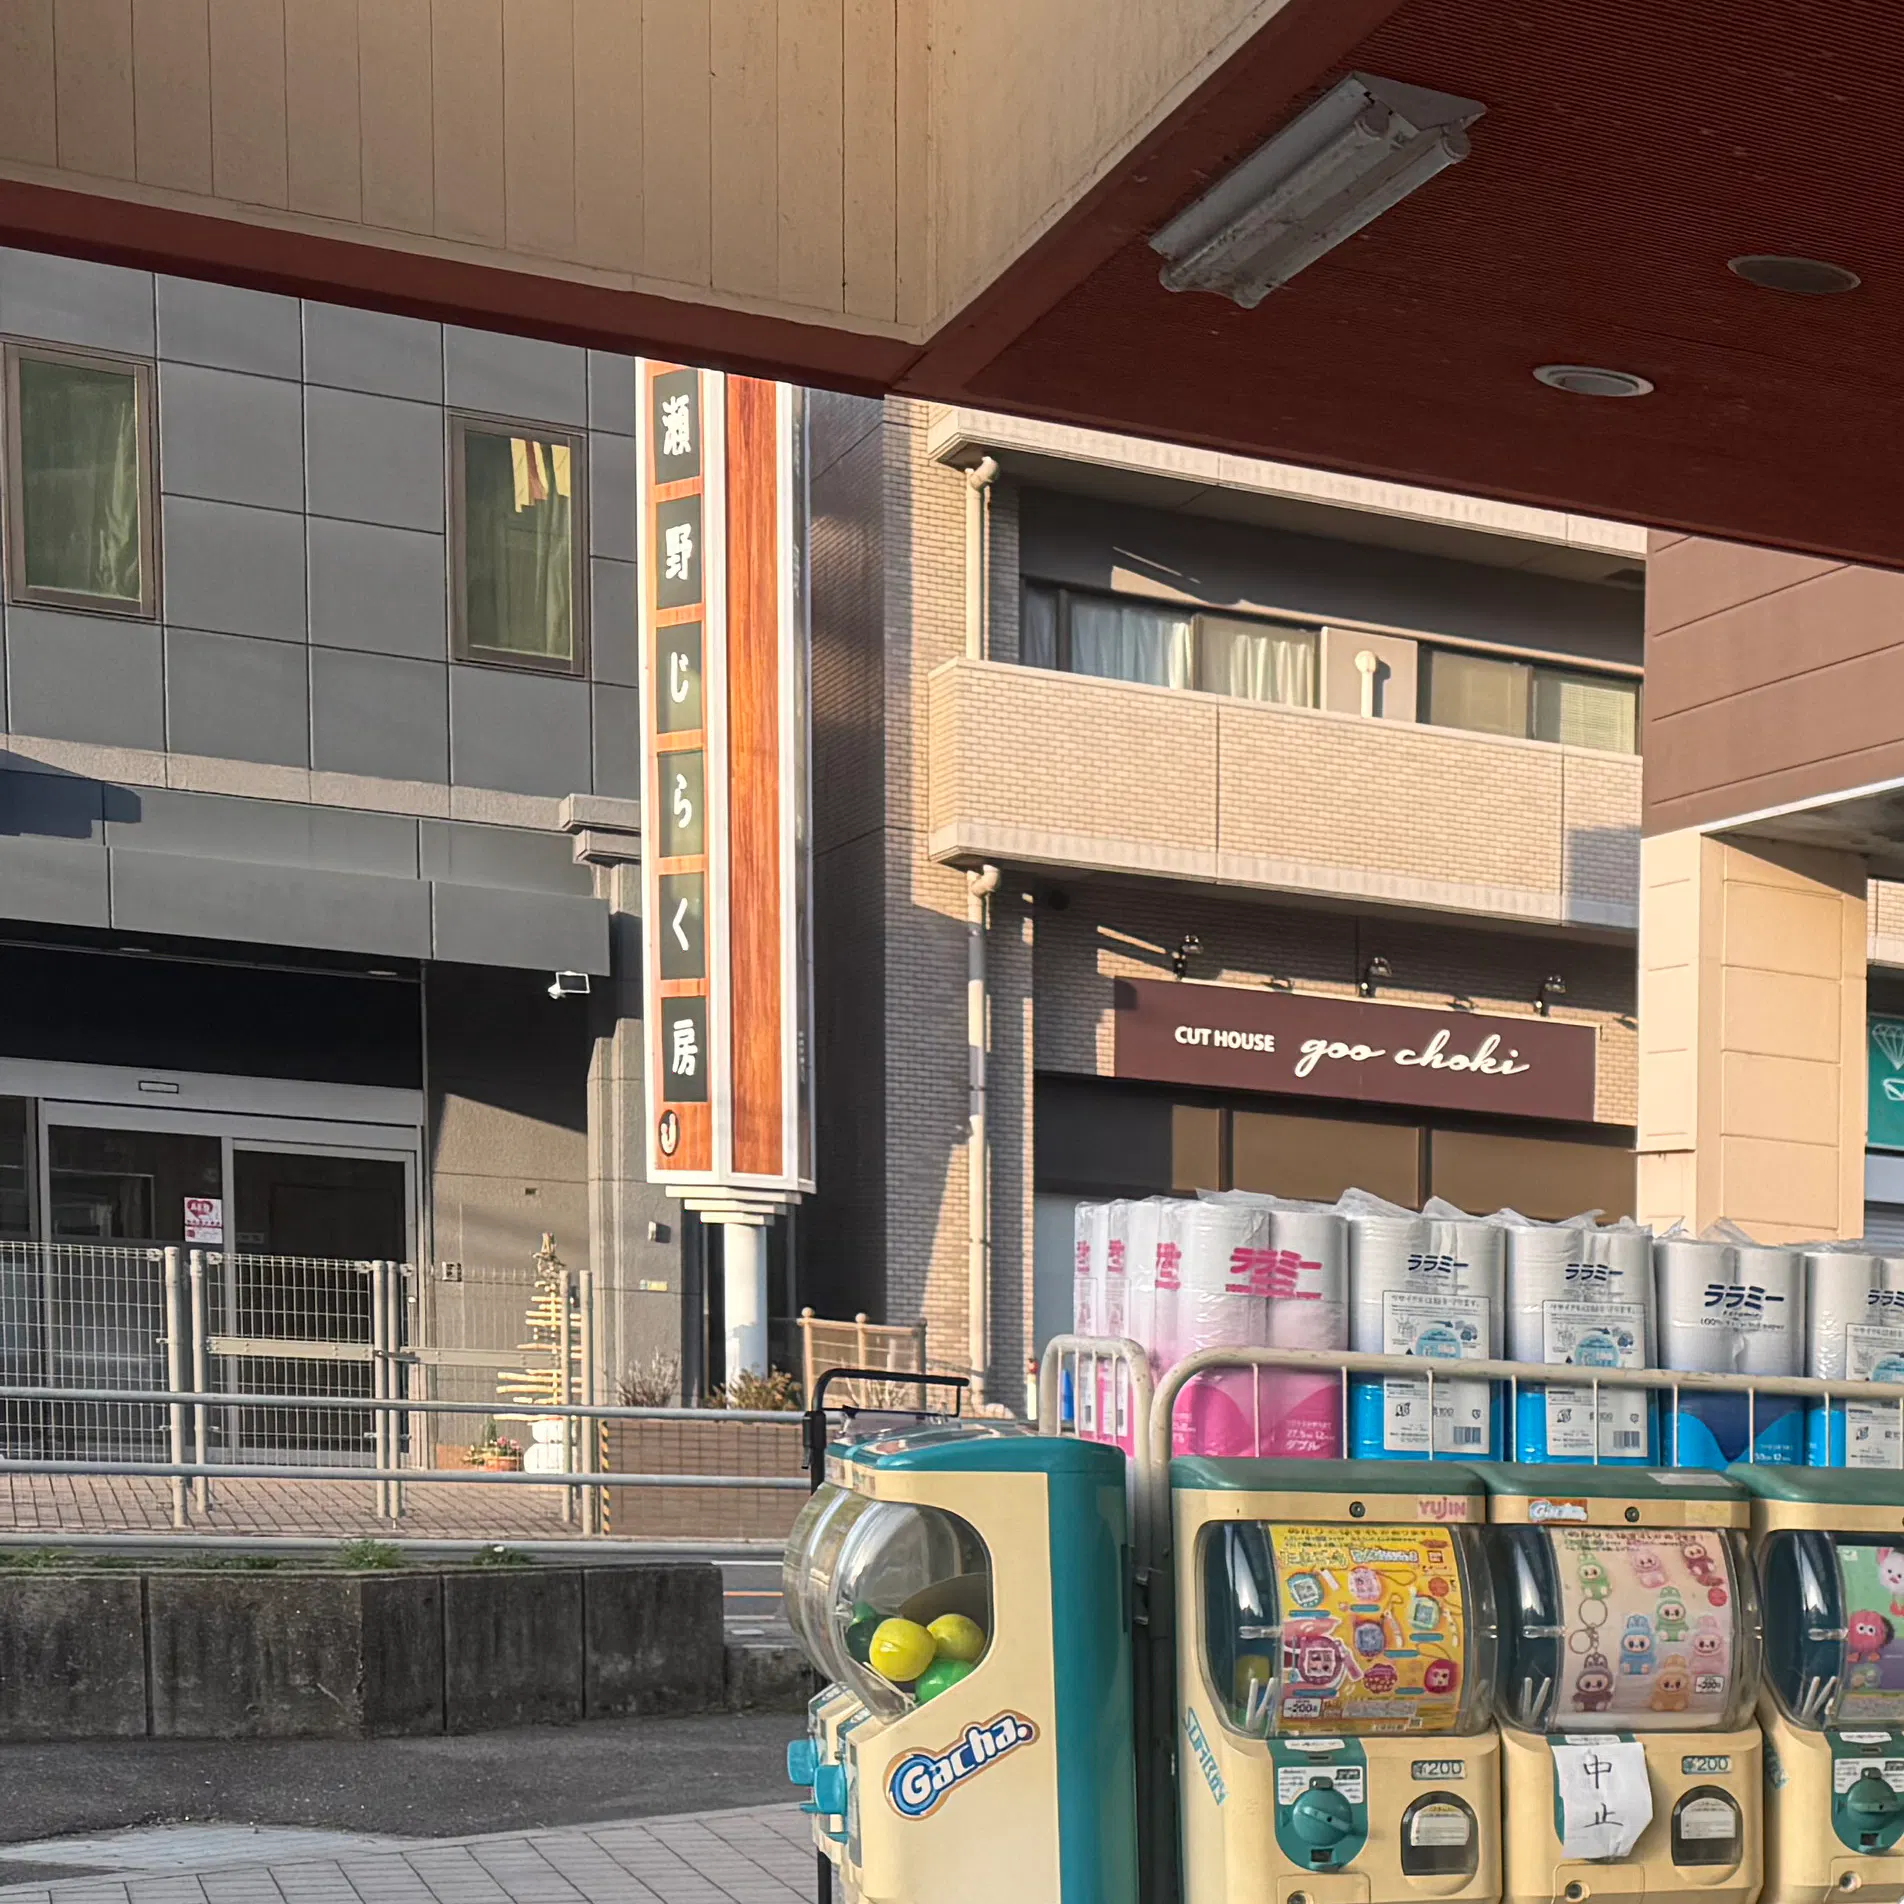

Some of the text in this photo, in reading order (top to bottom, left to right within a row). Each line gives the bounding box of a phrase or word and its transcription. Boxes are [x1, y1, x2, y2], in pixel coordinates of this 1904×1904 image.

[661, 377, 698, 1080] 瀬野じらく房
[1174, 1025, 1531, 1077] CUT HOUSE goo choki
[1408, 1253, 1469, 1273] ララミー
[1565, 1262, 1624, 1281] ララミー
[1704, 1283, 1785, 1310] ララミー
[1583, 1754, 1625, 1830] 中止
